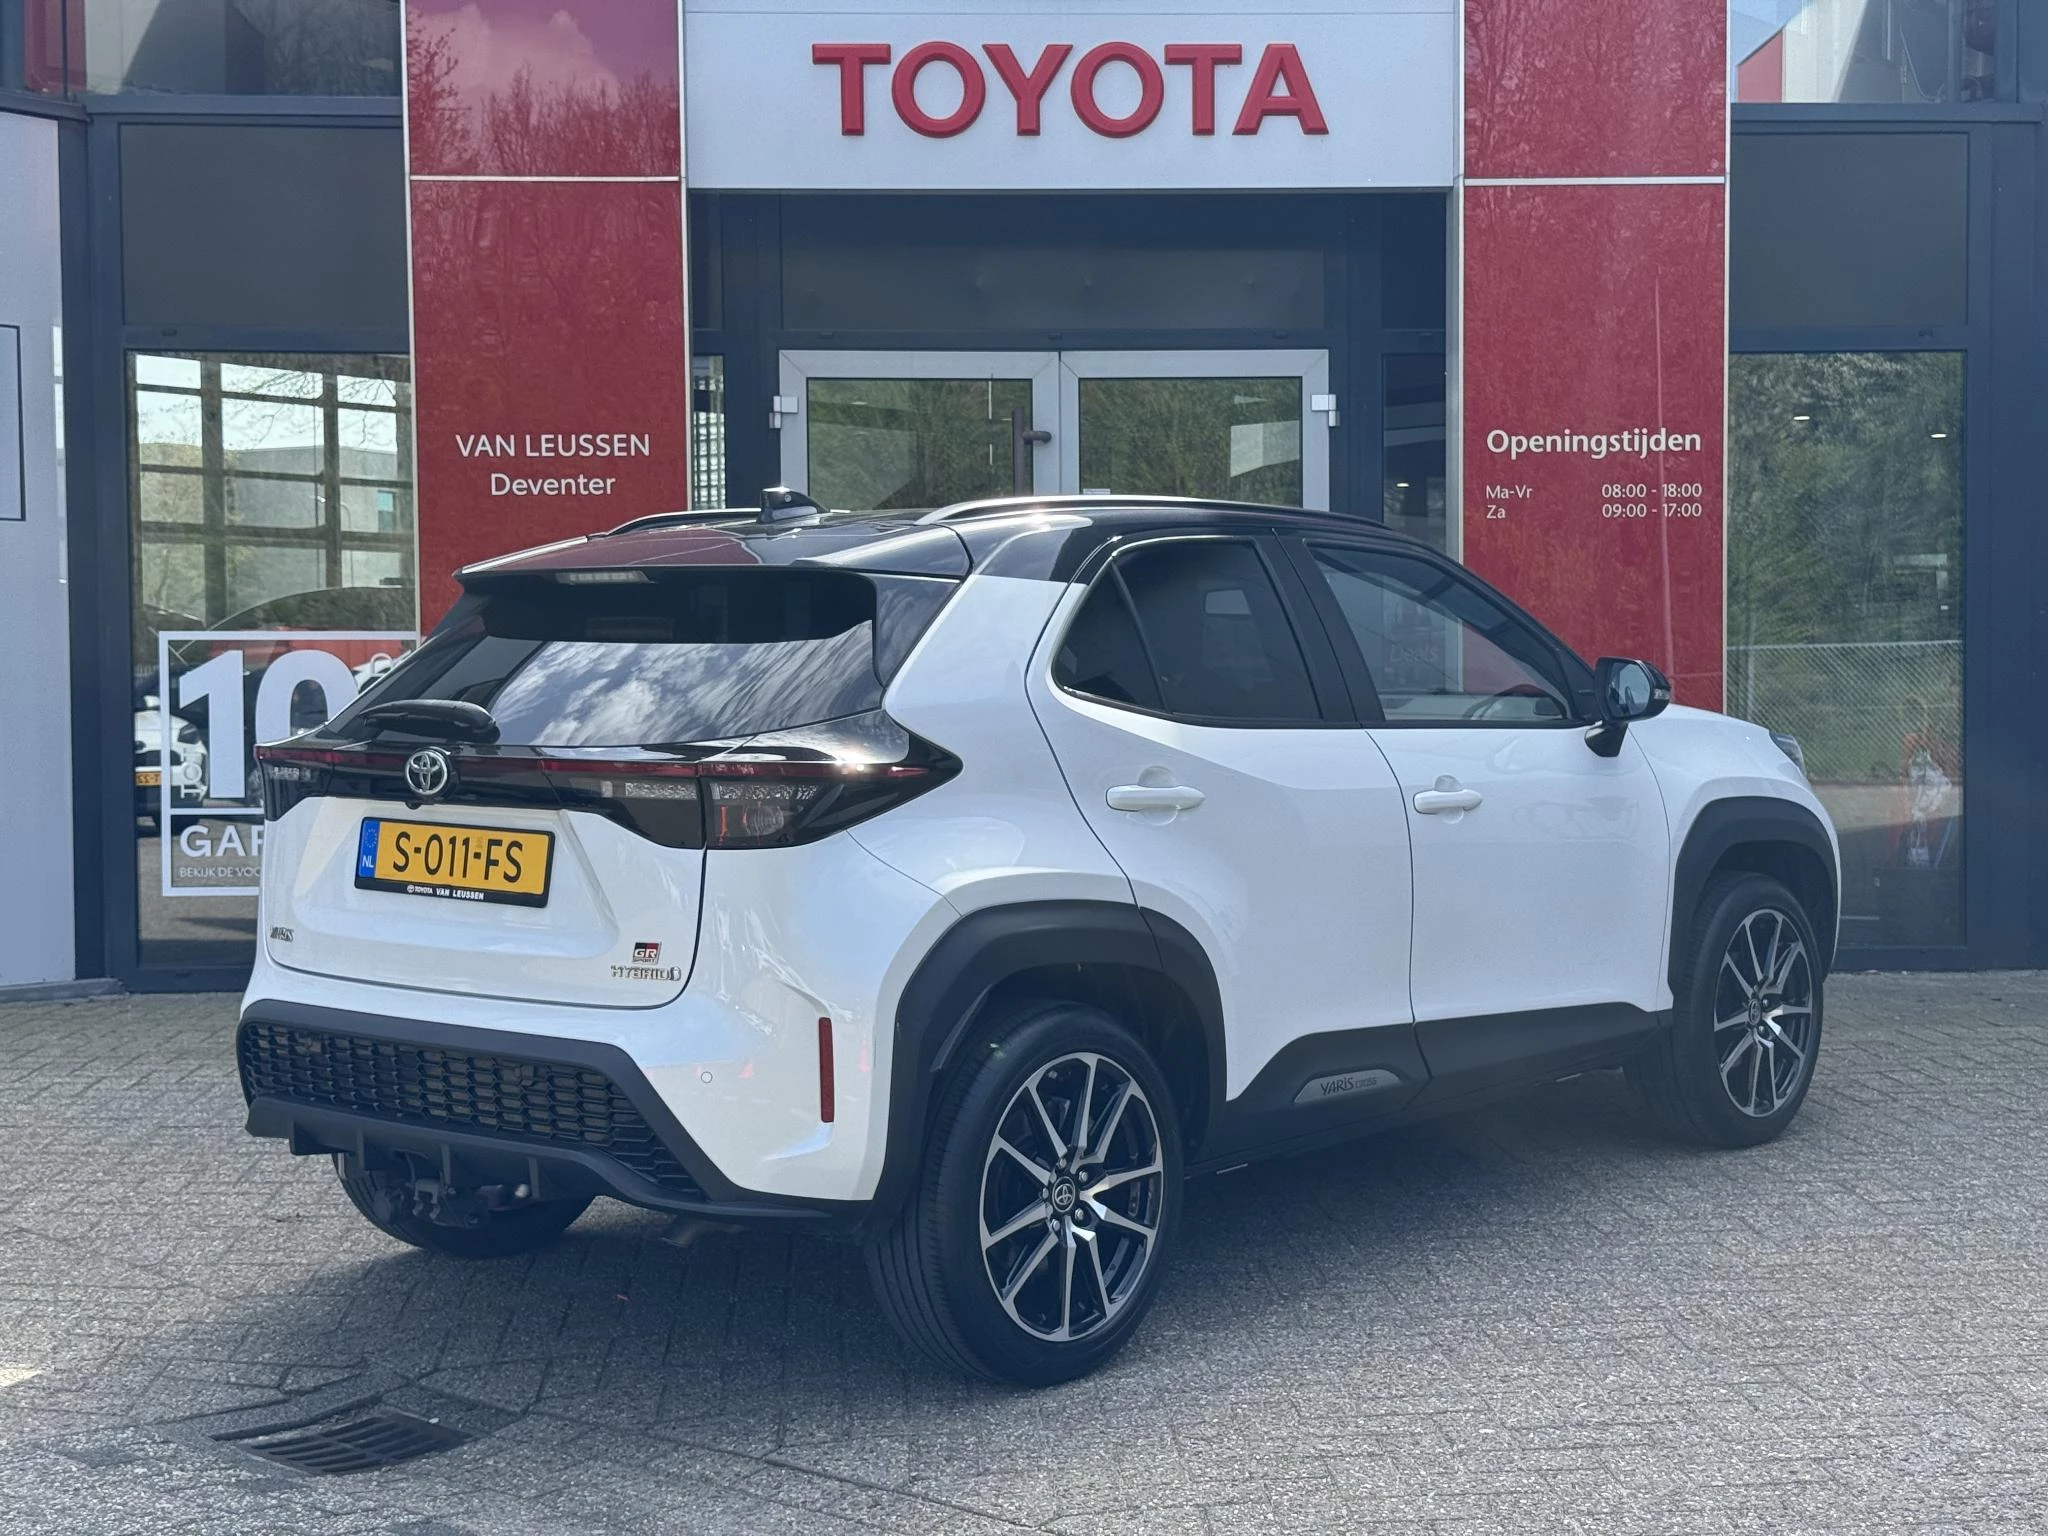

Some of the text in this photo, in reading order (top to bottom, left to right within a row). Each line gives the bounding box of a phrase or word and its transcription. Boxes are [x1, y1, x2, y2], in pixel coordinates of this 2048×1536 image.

[812, 41, 1329, 138] TOYOTA
[455, 433, 650, 457] VAN LEUSSEN
[1486, 427, 1702, 460] Openingstijden
[491, 473, 616, 496] Deventer
[1486, 485, 1533, 499] Ma-Vr
[1601, 484, 1647, 498] 08:00
[1662, 483, 1702, 498] 18:00
[1486, 504, 1506, 519] Za
[1602, 504, 1647, 518] 09:00
[1662, 503, 1702, 517] 17:00
[362, 855, 375, 868] NL
[392, 831, 523, 883] S-011-FS
[436, 887, 450, 897] VAN
[453, 889, 484, 901] LEUSSEN
[634, 948, 657, 958] GR
[1320, 1077, 1354, 1095] YARIS
